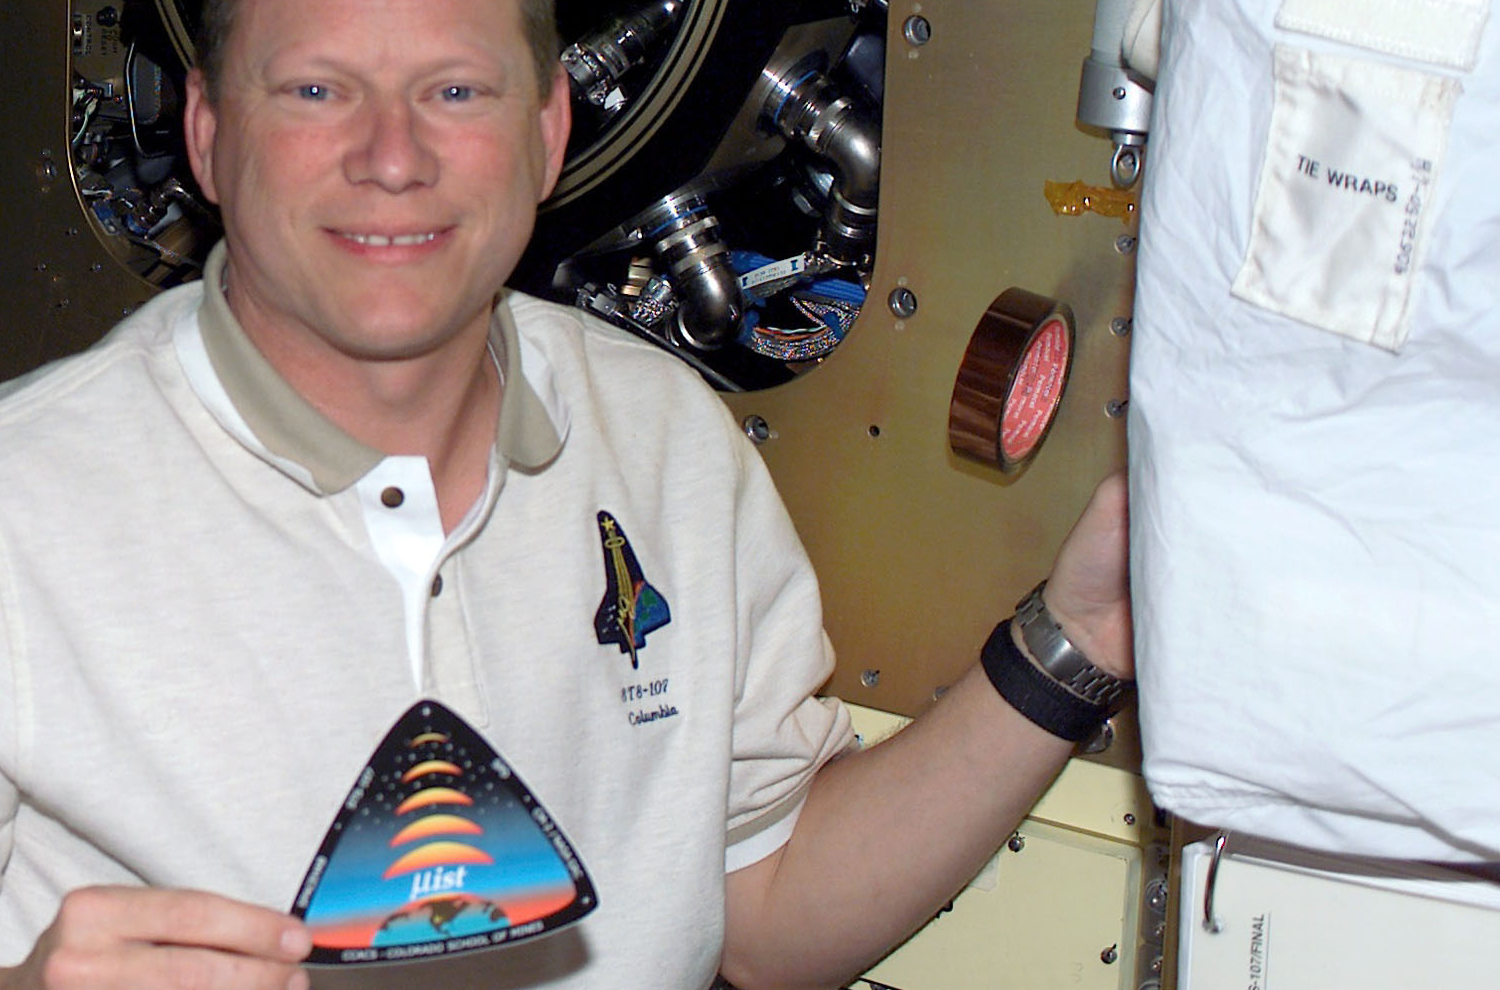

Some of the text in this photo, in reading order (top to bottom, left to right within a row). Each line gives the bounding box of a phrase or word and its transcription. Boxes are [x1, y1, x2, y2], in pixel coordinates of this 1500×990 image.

[1297, 154, 1398, 203] TIE WRAPS
[628, 704, 680, 727] Columbia
[386, 941, 445, 959] COLORADO
[448, 934, 489, 953] SCHOOL
[491, 931, 508, 945] OF
[509, 921, 545, 940] MINES
